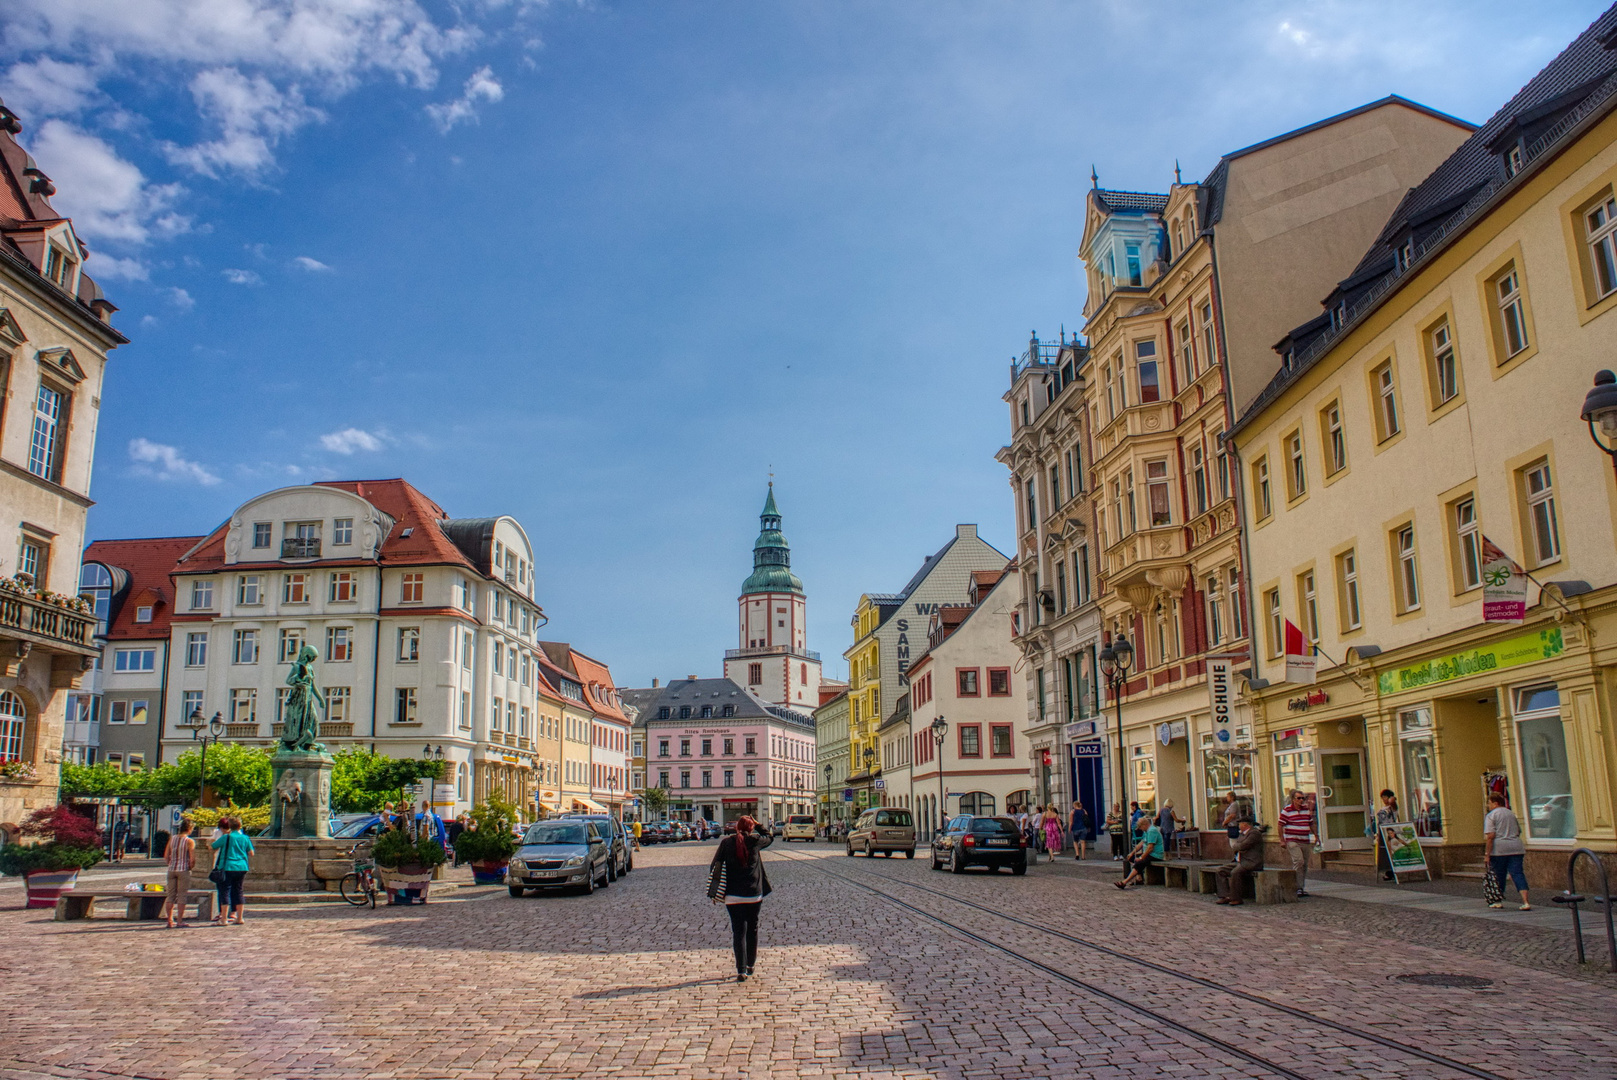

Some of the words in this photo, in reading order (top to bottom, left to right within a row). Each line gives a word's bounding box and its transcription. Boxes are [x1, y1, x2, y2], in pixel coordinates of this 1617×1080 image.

[1485, 610, 1519, 618] Festmoden
[897, 619, 909, 686] SAMEN
[1400, 651, 1497, 689] Kleeblatt-Moden
[1213, 664, 1230, 724] SCHUHE
[1078, 745, 1099, 754] DAZ
